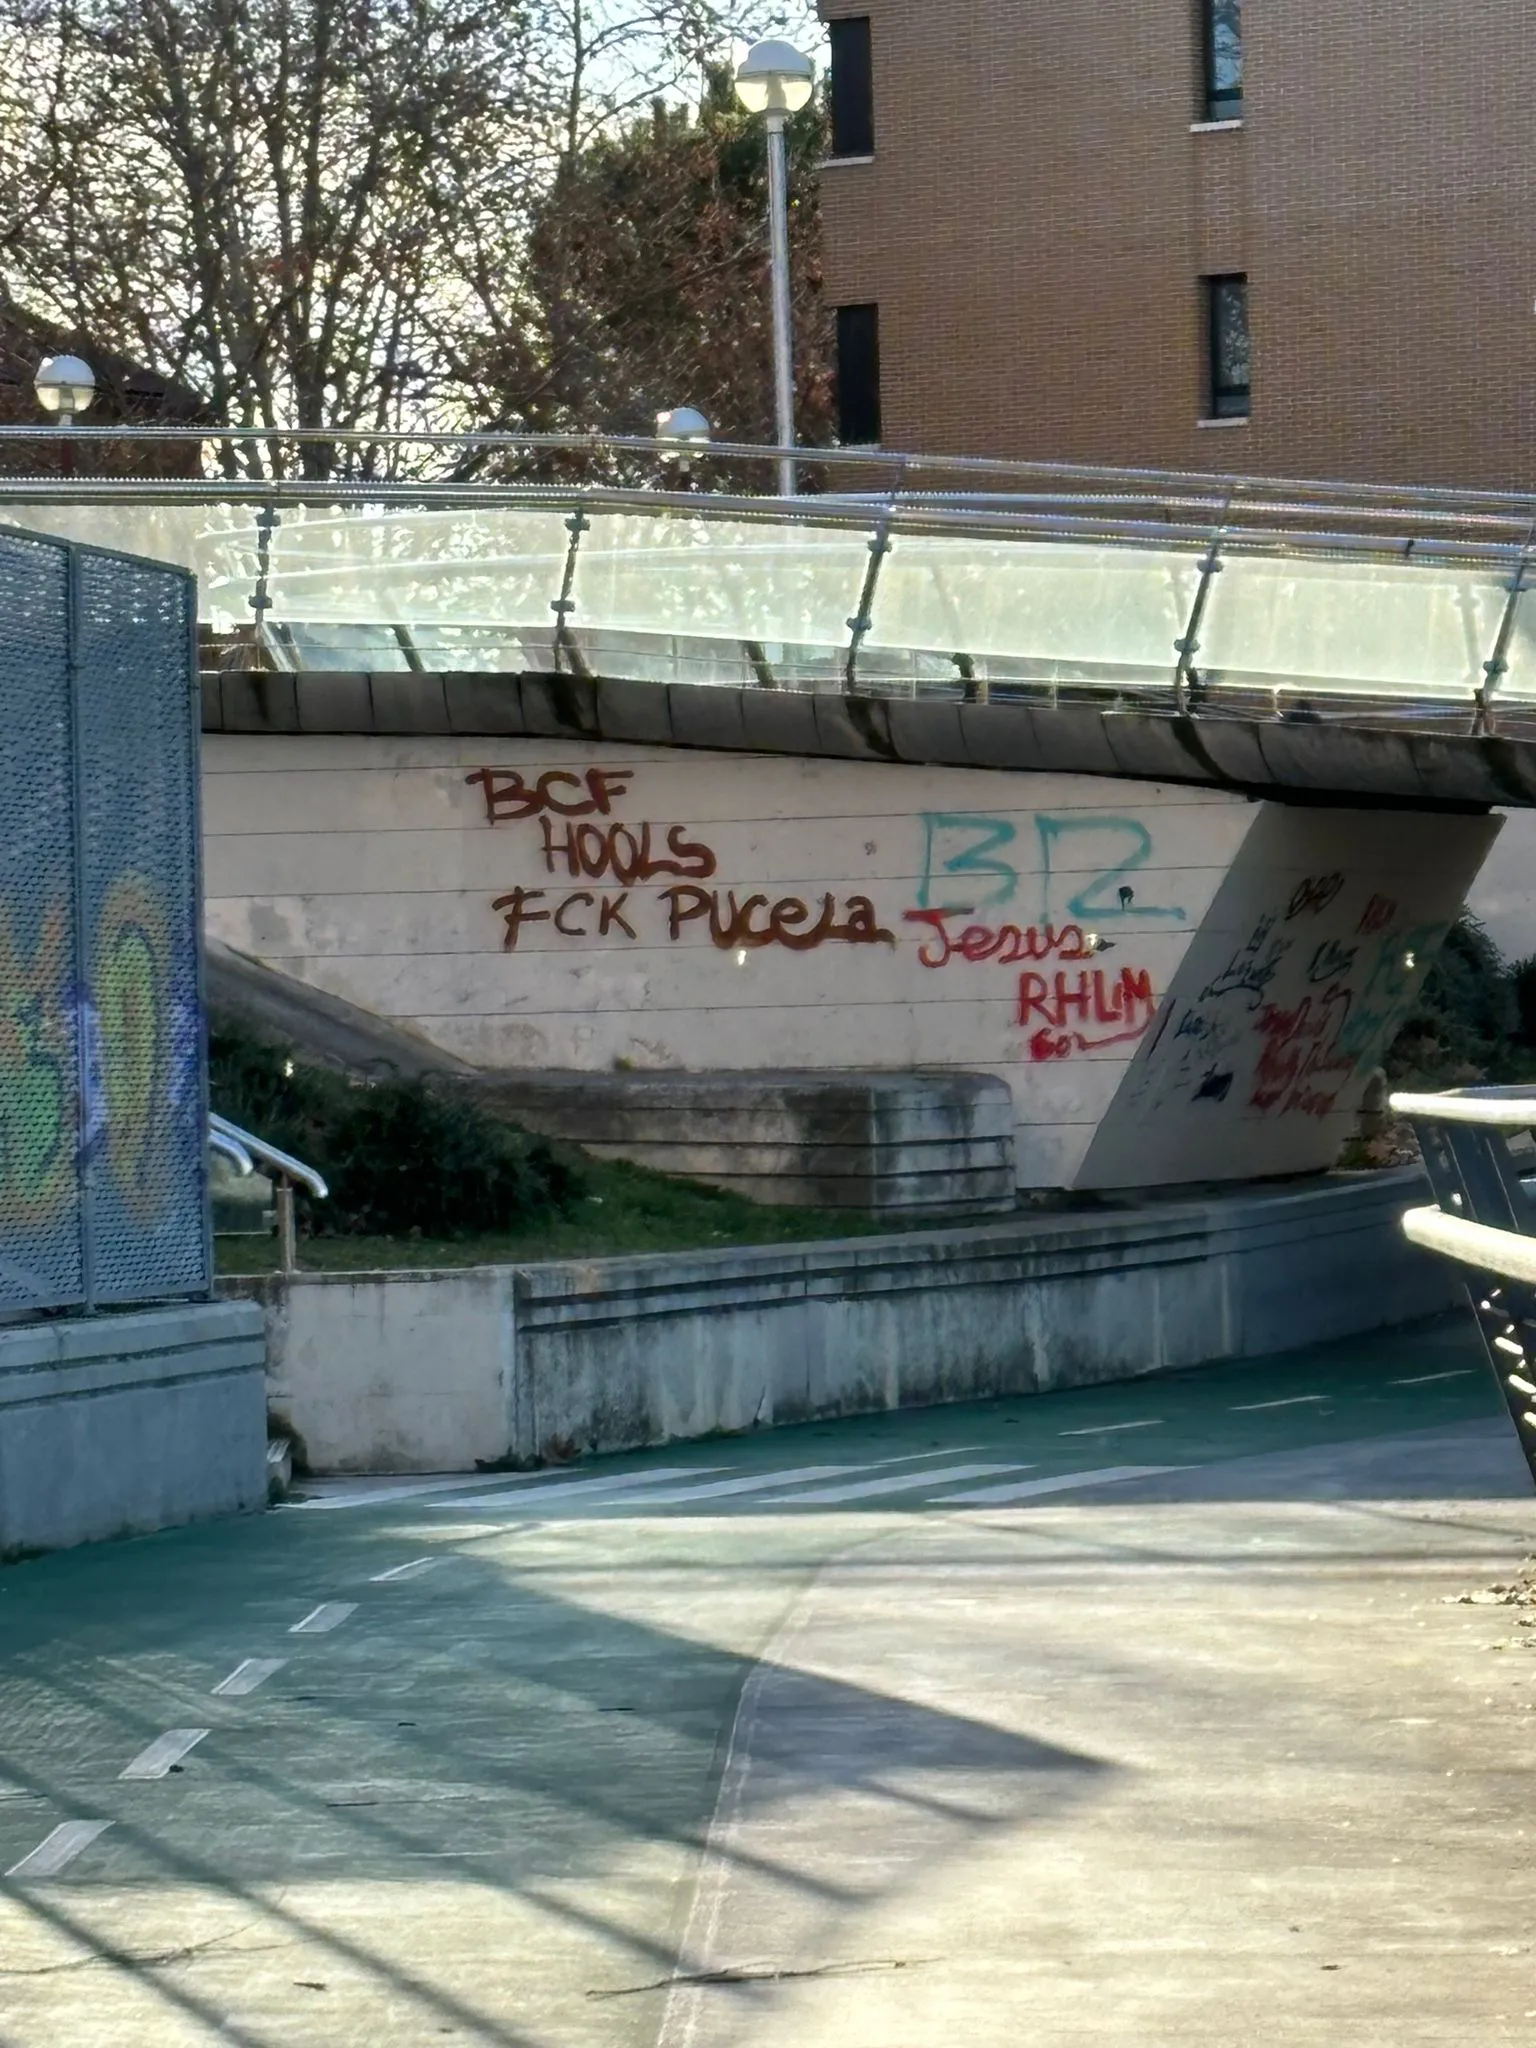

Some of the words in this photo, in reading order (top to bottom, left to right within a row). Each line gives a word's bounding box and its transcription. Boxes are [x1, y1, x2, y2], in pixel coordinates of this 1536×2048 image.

[464, 767, 634, 825] BCF
[539, 814, 717, 887] HOOLS
[492, 886, 637, 952] FCK
